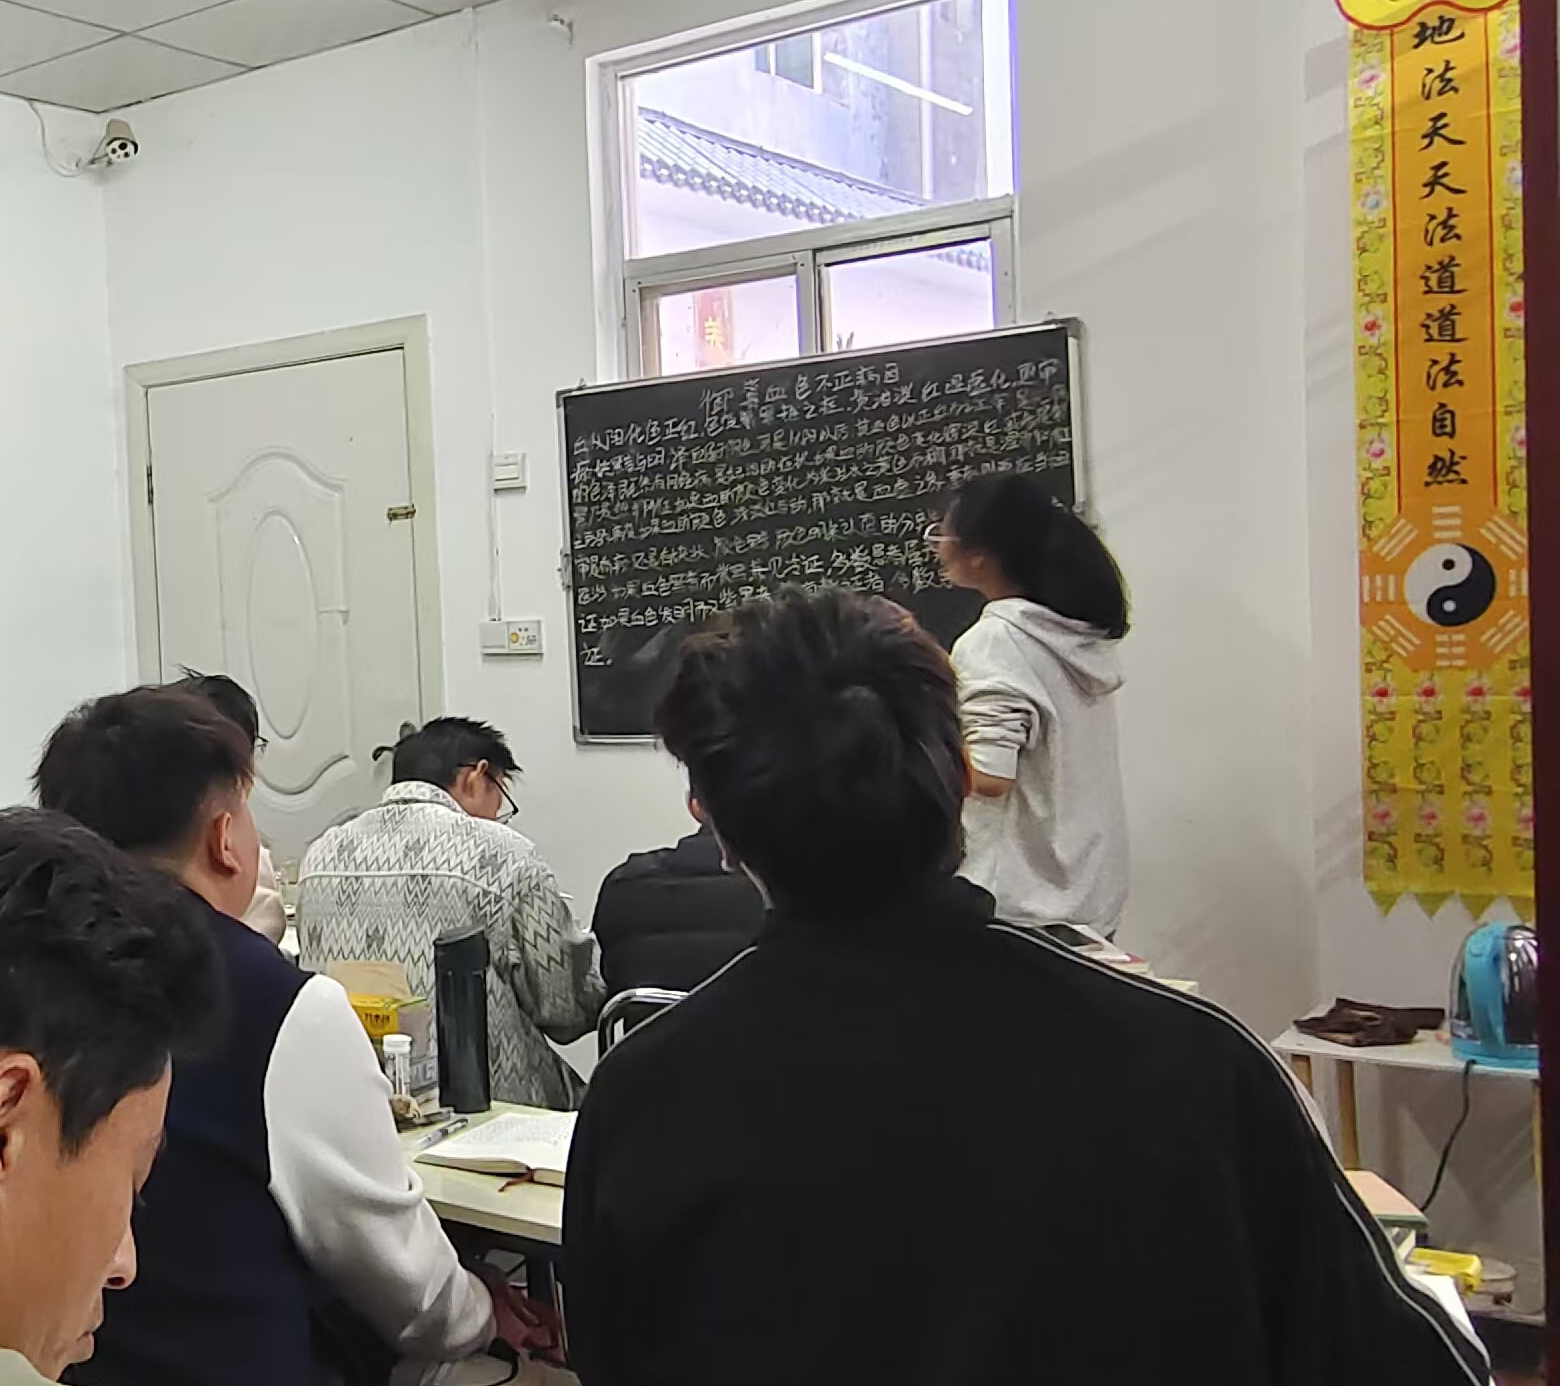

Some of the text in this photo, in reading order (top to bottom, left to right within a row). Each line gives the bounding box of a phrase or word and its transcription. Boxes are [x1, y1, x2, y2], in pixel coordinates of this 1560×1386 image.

[1411, 14, 1469, 488] 地法天天法道道法自然
